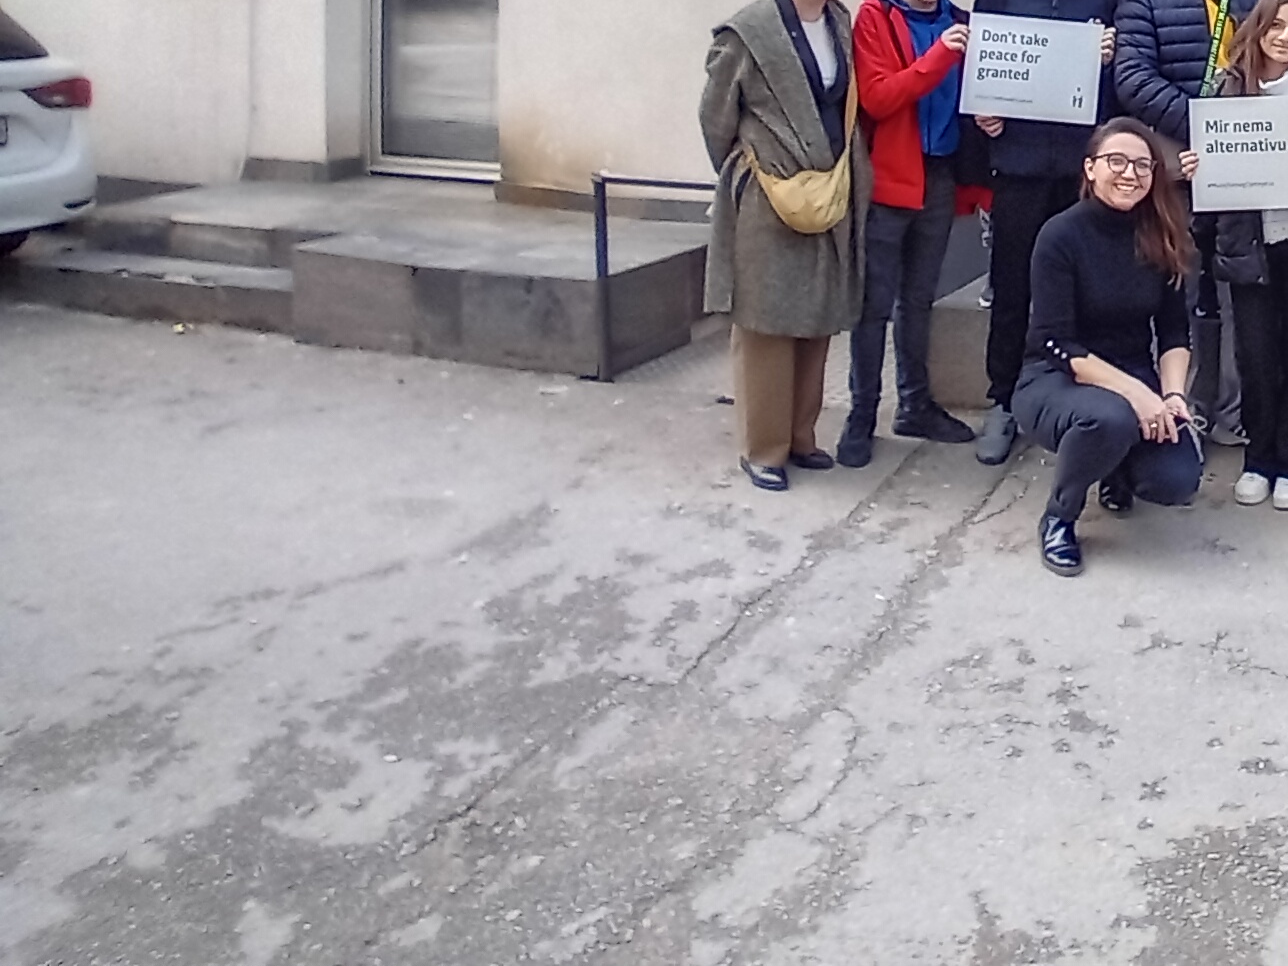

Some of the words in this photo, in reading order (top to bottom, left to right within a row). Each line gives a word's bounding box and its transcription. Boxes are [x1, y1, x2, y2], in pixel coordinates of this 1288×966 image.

[982, 29, 1017, 44] Don't
[1020, 34, 1048, 47] take
[979, 49, 1018, 62] peace
[1021, 50, 1041, 64] for
[976, 67, 1030, 81] granted
[1205, 120, 1230, 133] Mir
[1233, 120, 1273, 133] nema
[1205, 138, 1287, 153] alternativu
